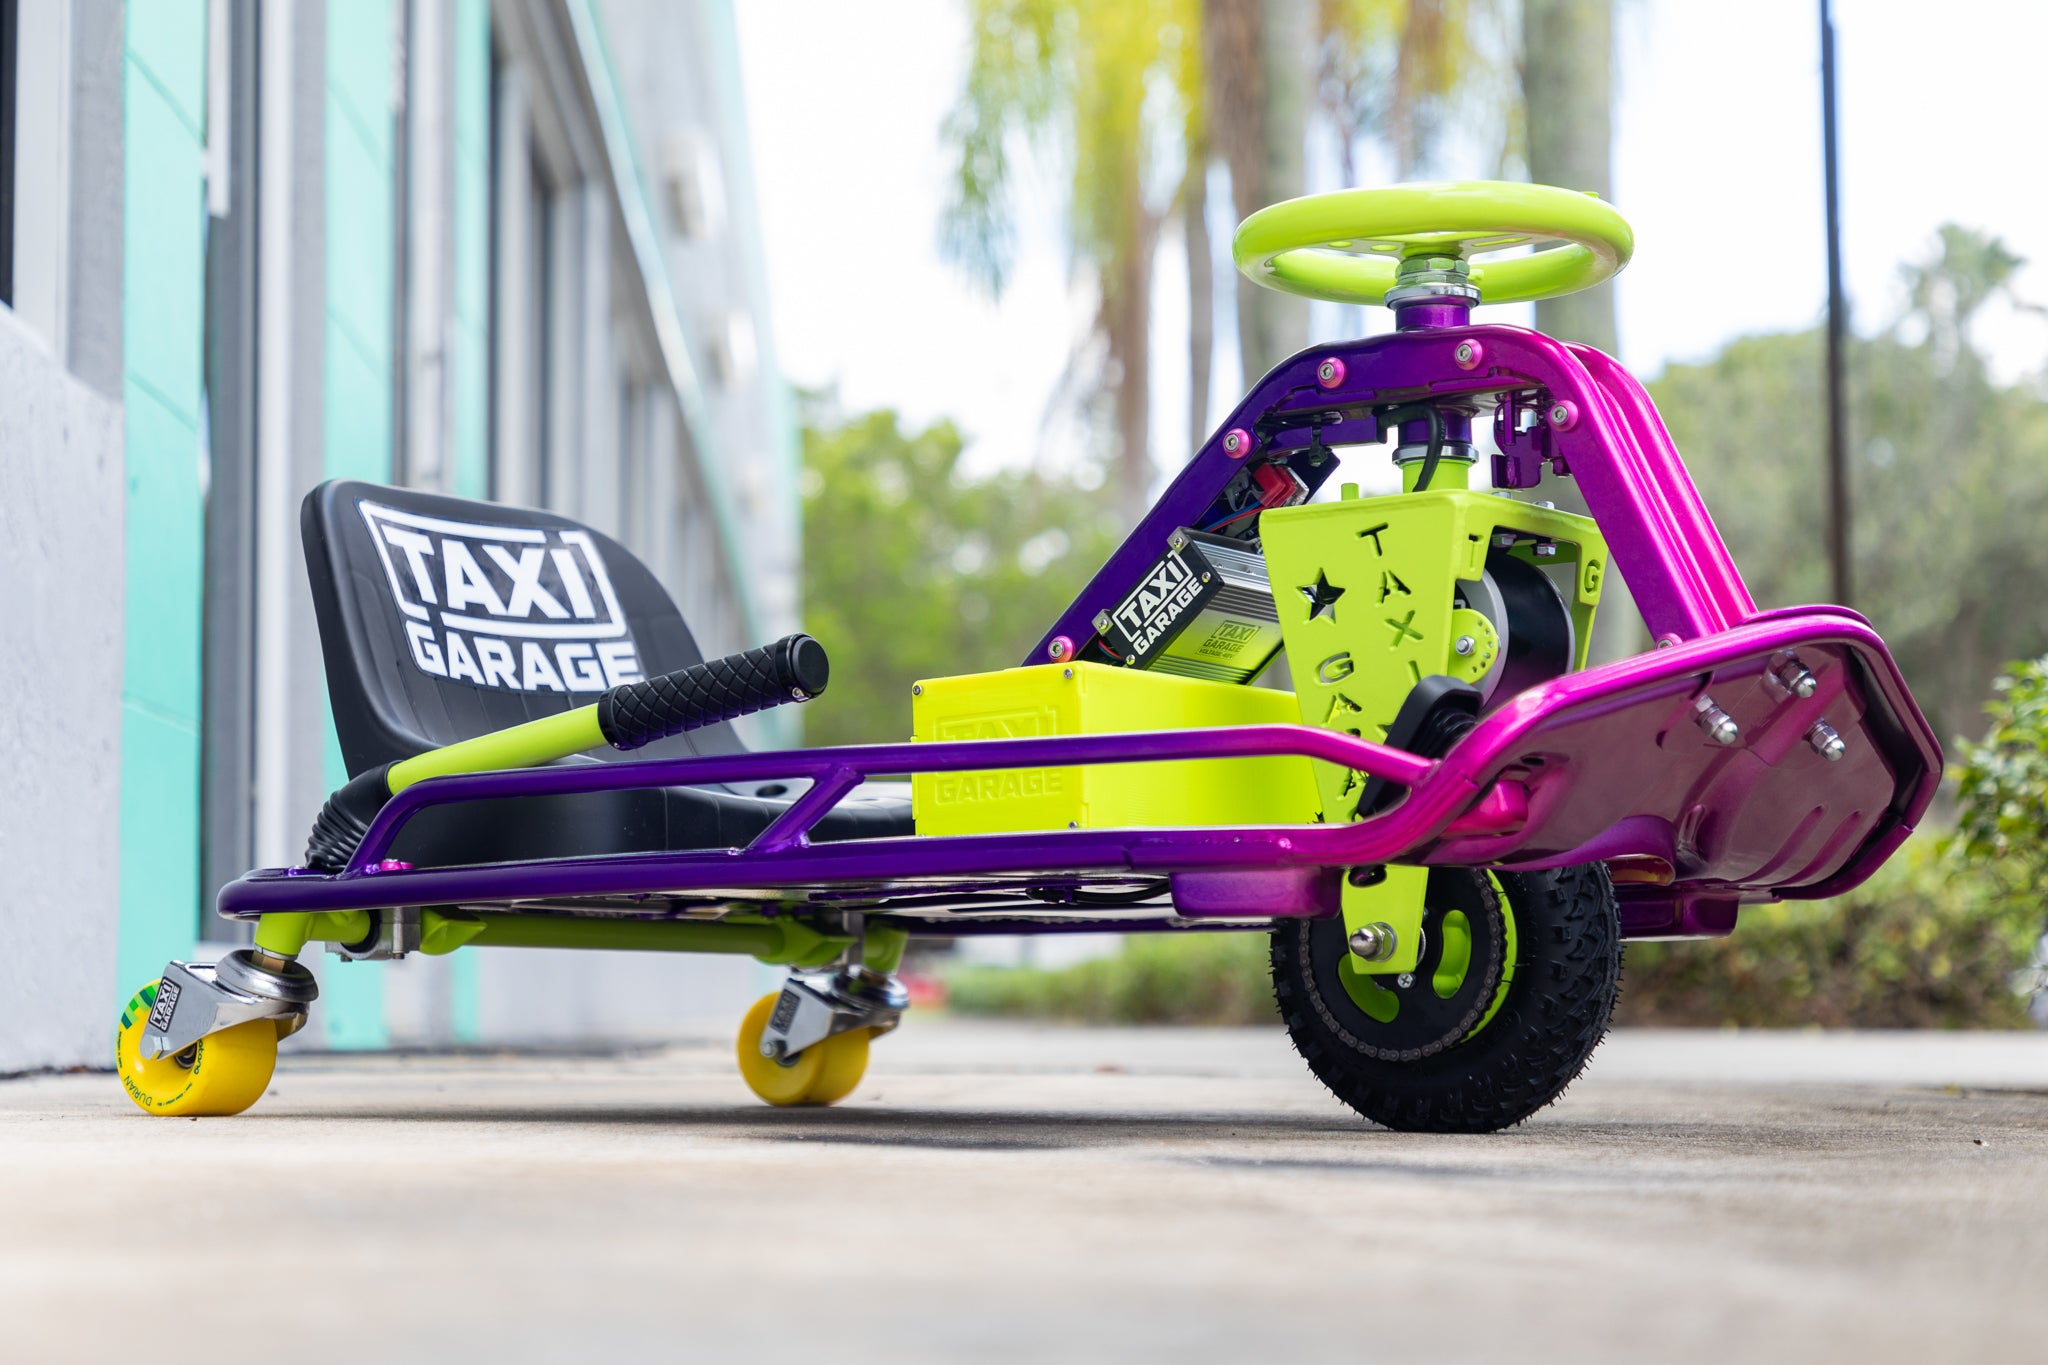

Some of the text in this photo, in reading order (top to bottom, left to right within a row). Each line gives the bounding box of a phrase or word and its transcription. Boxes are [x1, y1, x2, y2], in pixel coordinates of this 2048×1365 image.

[382, 524, 597, 619] TAXI
[1120, 559, 1184, 628] TAXI
[1133, 577, 1203, 655] GARAGE
[1219, 623, 1255, 641] TAXI
[405, 619, 644, 692] GARAGE
[1203, 639, 1244, 652] GARAGE
[935, 769, 1063, 805] GARAGE
[153, 983, 171, 1021] TAXI
[161, 985, 180, 1031] GARAGE
[124, 1075, 153, 1107] DURIAN
